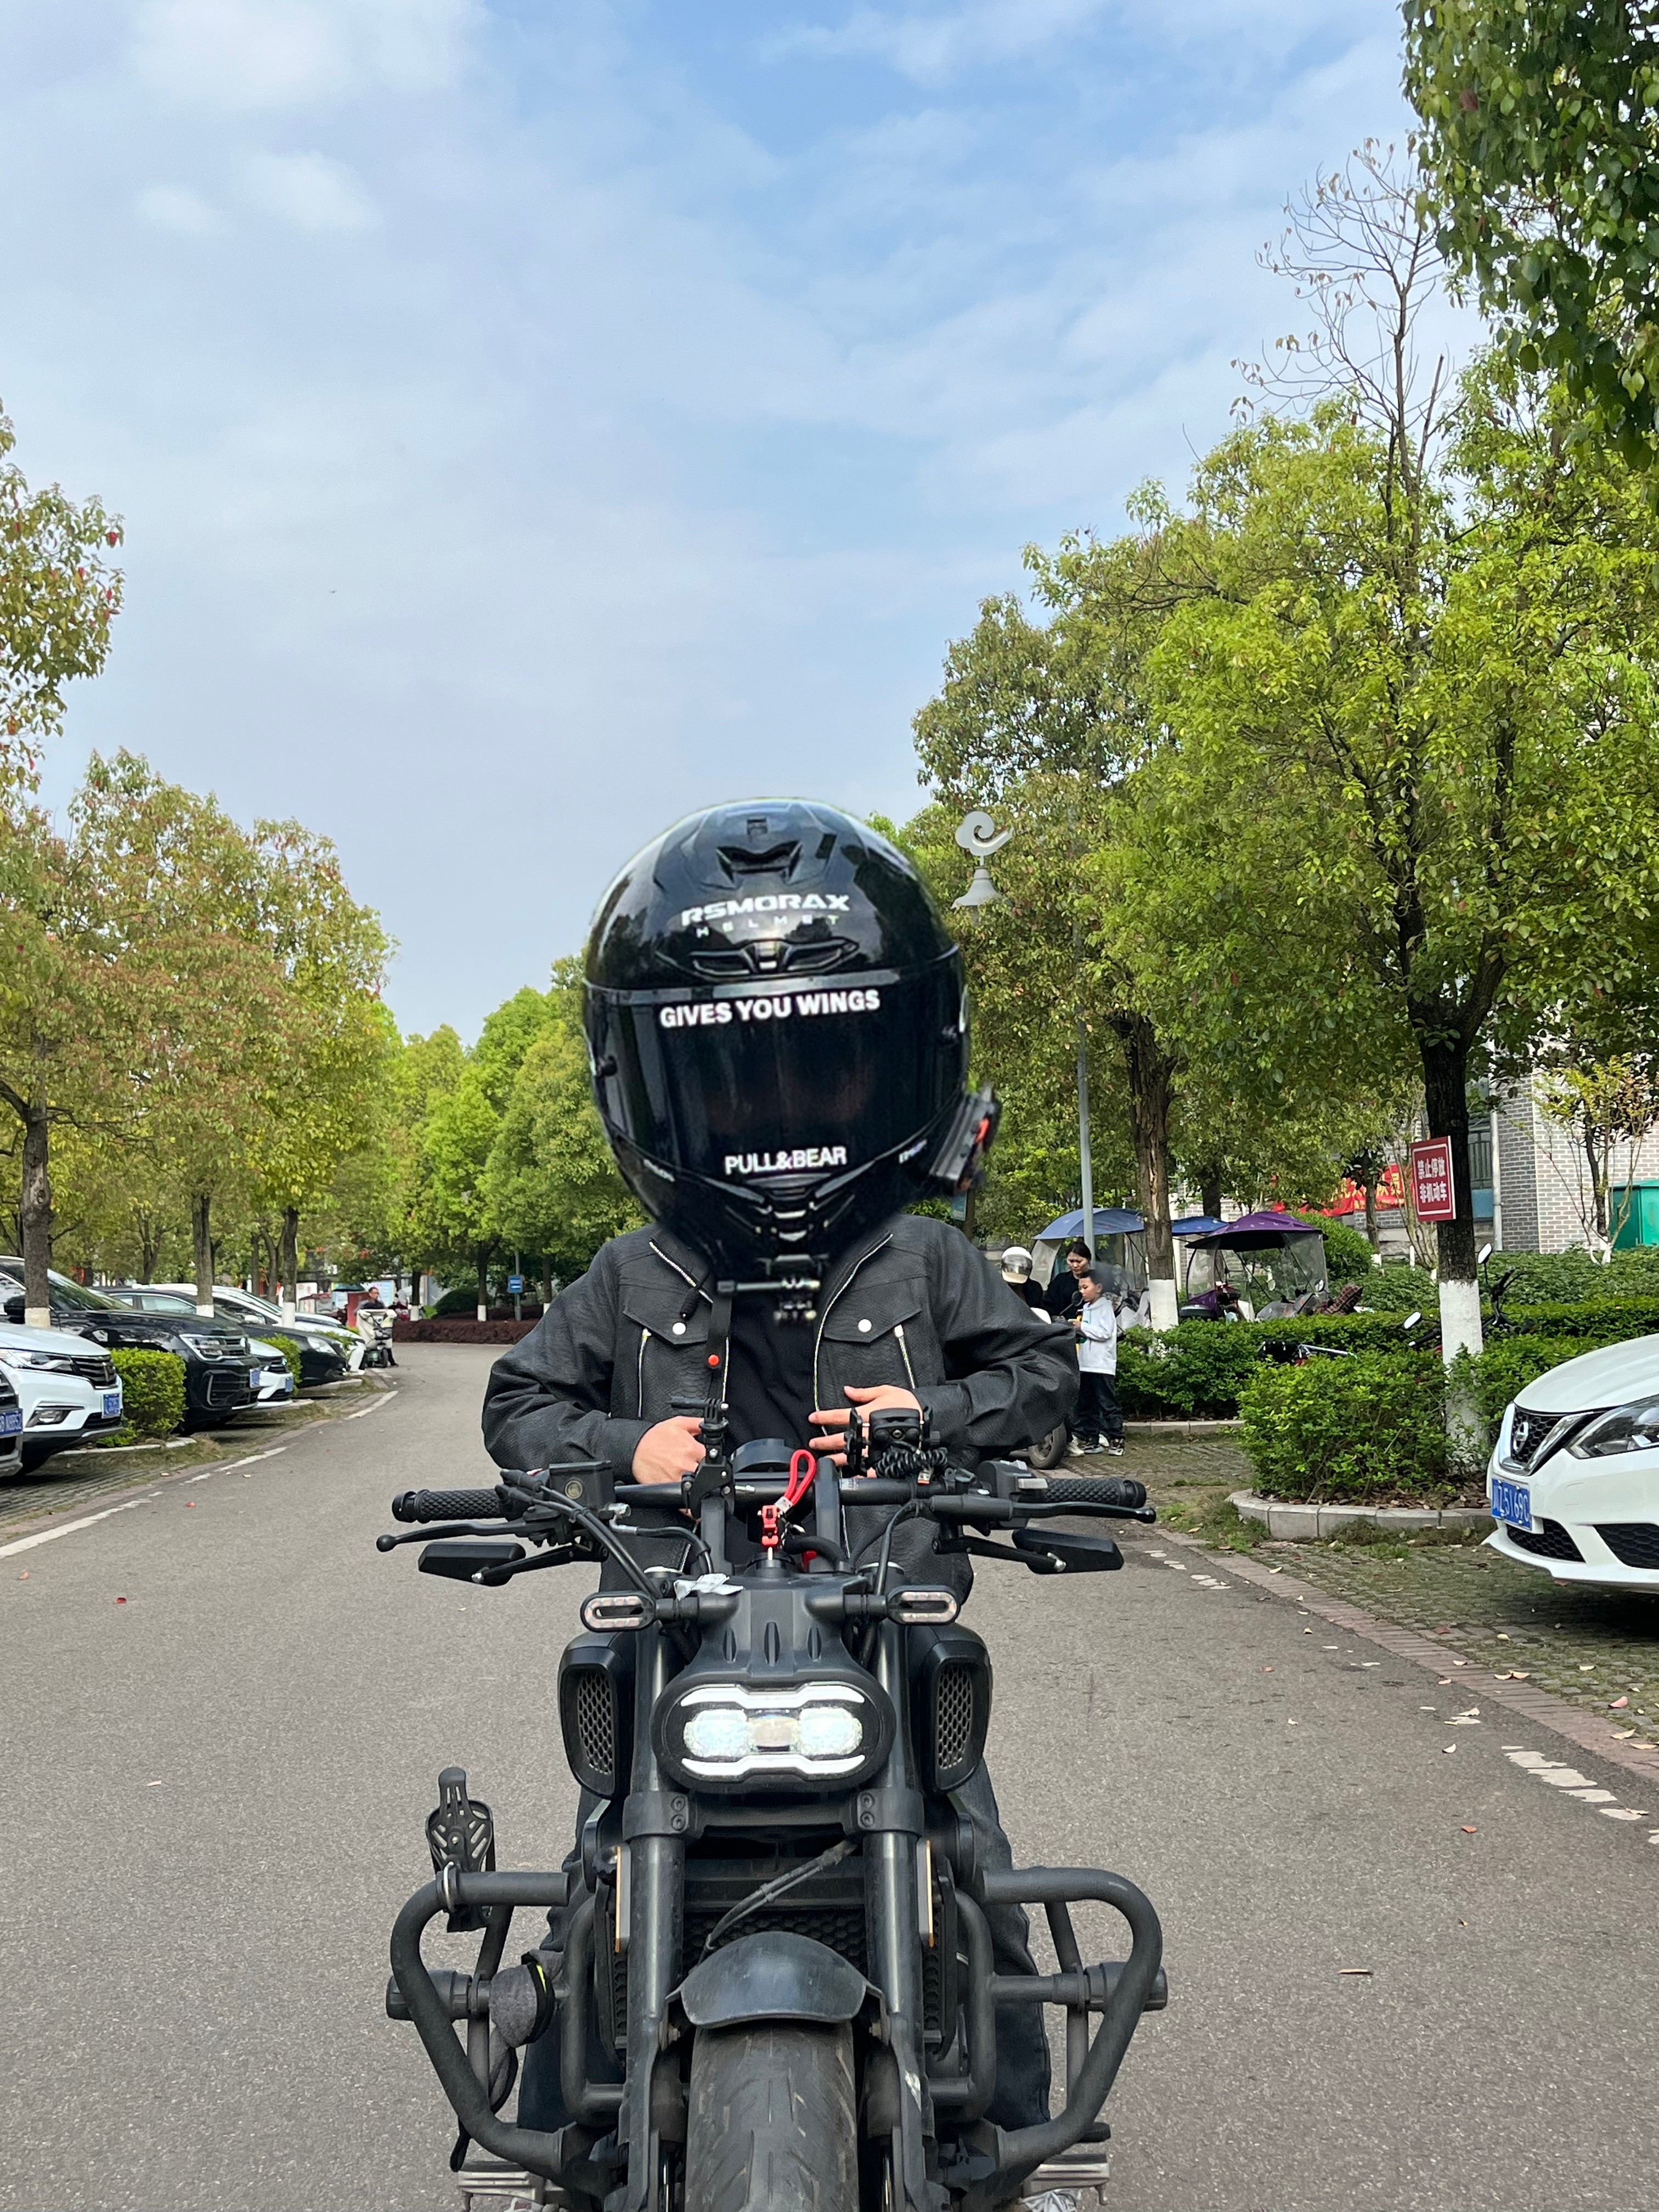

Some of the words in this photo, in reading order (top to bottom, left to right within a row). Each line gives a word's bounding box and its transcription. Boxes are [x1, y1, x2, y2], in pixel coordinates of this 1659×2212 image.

[681, 894, 850, 927] RSMORAX
[696, 914, 839, 938] HELMET
[660, 1002, 733, 1029] GIVES
[735, 996, 792, 1022] YOU
[795, 989, 881, 1016] WINGS
[724, 1146, 847, 1175] PULL&BEAR
[1417, 1156, 1446, 1180] 禁止停放
[1419, 1181, 1448, 1204] 非机动车
